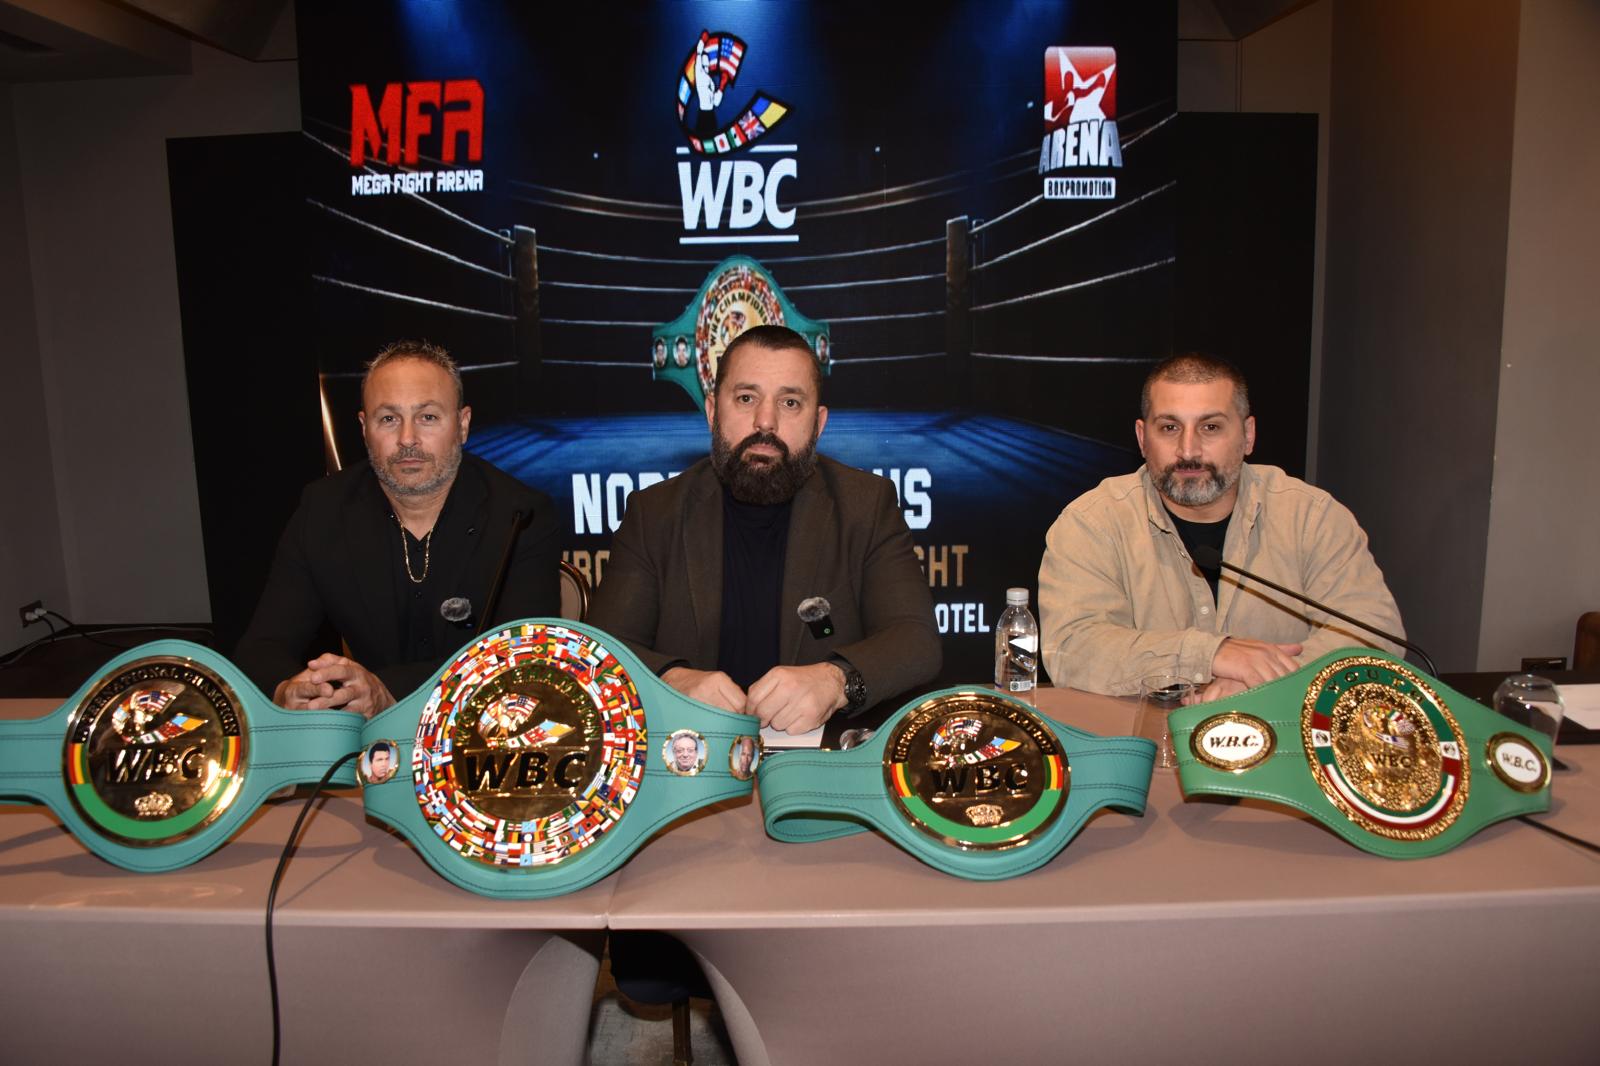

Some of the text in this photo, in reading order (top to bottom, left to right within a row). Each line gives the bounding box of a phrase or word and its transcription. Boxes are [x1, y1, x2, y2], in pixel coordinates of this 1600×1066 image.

[349, 79, 484, 167] MFA
[1039, 120, 1123, 174] ARENA
[351, 169, 483, 195] MEGA FIGHT ARENA
[677, 158, 797, 230] WBC
[1048, 180, 1112, 196] BOXPROMOTION
[572, 472, 682, 534] NO
[76, 667, 180, 743] TERNATIONAL
[513, 665, 600, 742] CHAMPION
[1326, 669, 1424, 703] YOUTH
[989, 702, 1054, 754] AMPION
[1210, 735, 1260, 748] W.B.C.
[105, 747, 204, 782] WBC
[466, 752, 588, 791] WBC
[932, 763, 1029, 795] WBC
[1370, 753, 1412, 769] WBC
